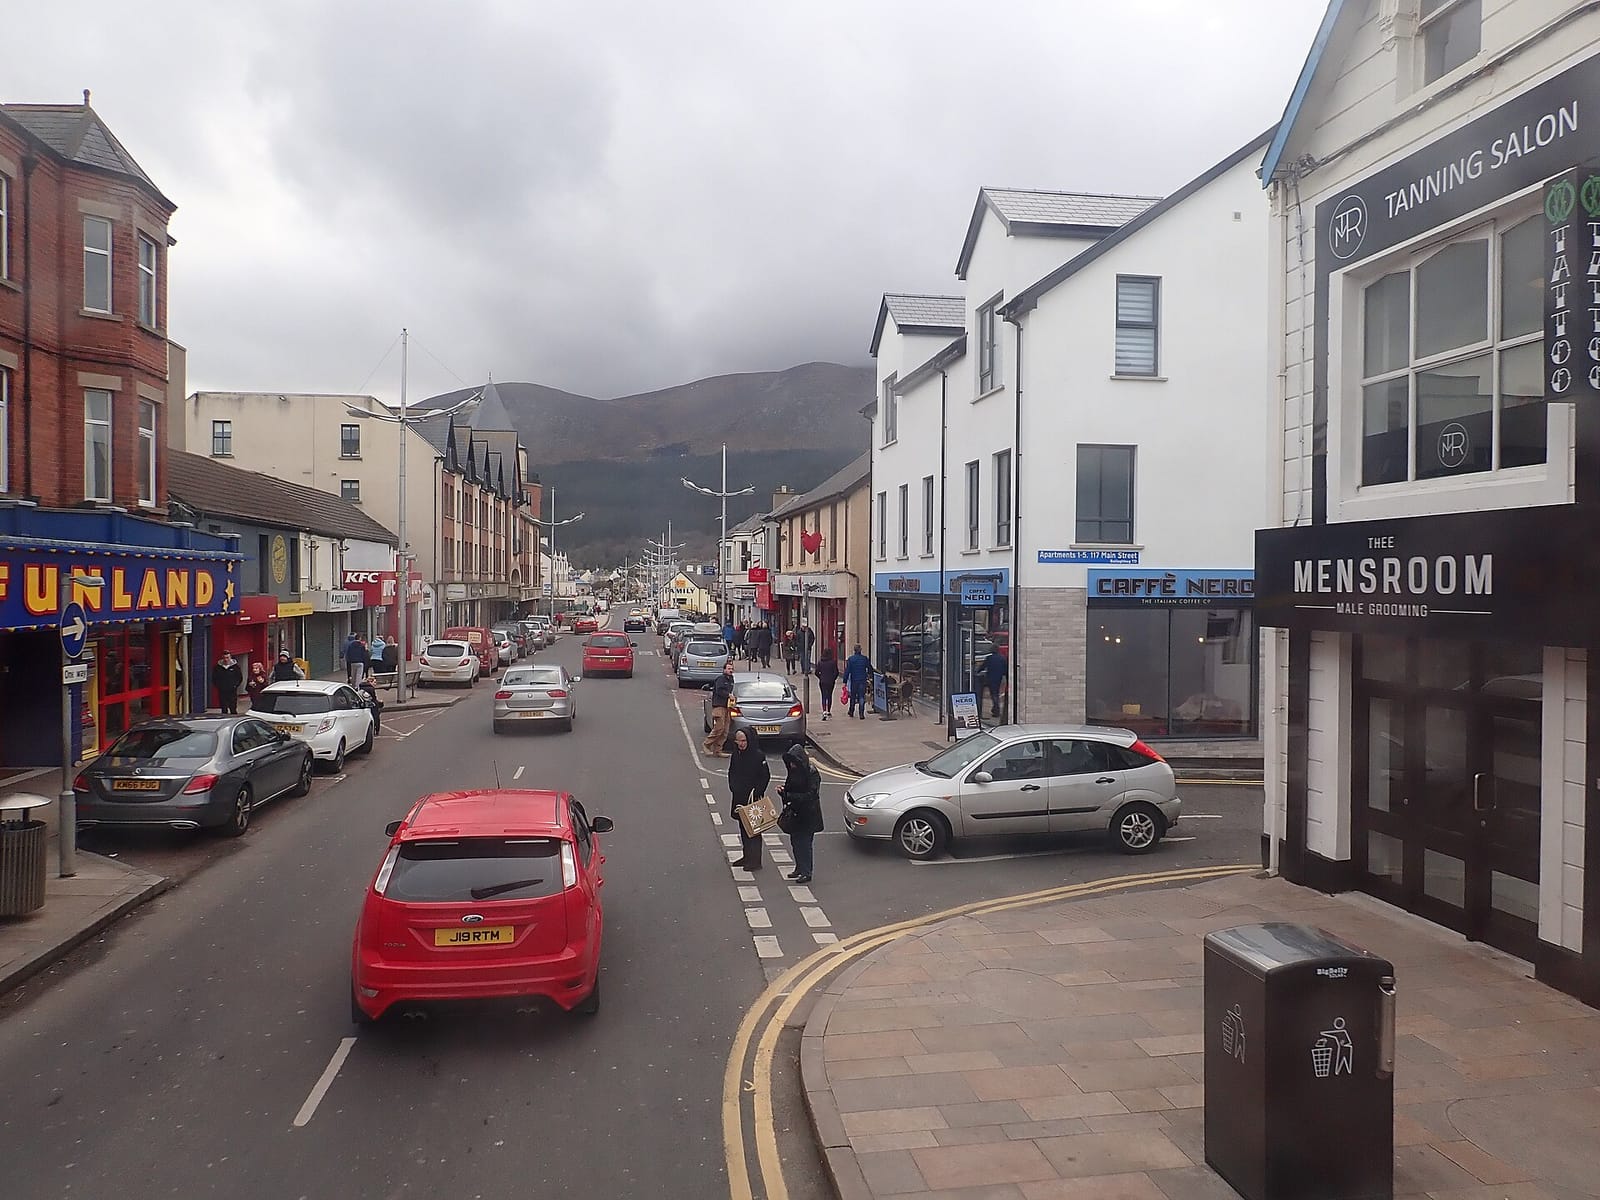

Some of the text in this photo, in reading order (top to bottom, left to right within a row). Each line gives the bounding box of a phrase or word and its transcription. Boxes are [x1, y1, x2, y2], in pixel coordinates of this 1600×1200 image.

[1384, 100, 1578, 219] TANNING SALON
[1367, 535, 1395, 549] THEE
[1039, 551, 1076, 560] Apartments
[344, 571, 379, 583] KFC
[1293, 554, 1493, 595] MENSROOM
[1336, 602, 1428, 617] MALE GROOMING
[449, 930, 500, 943] J19 RTM
